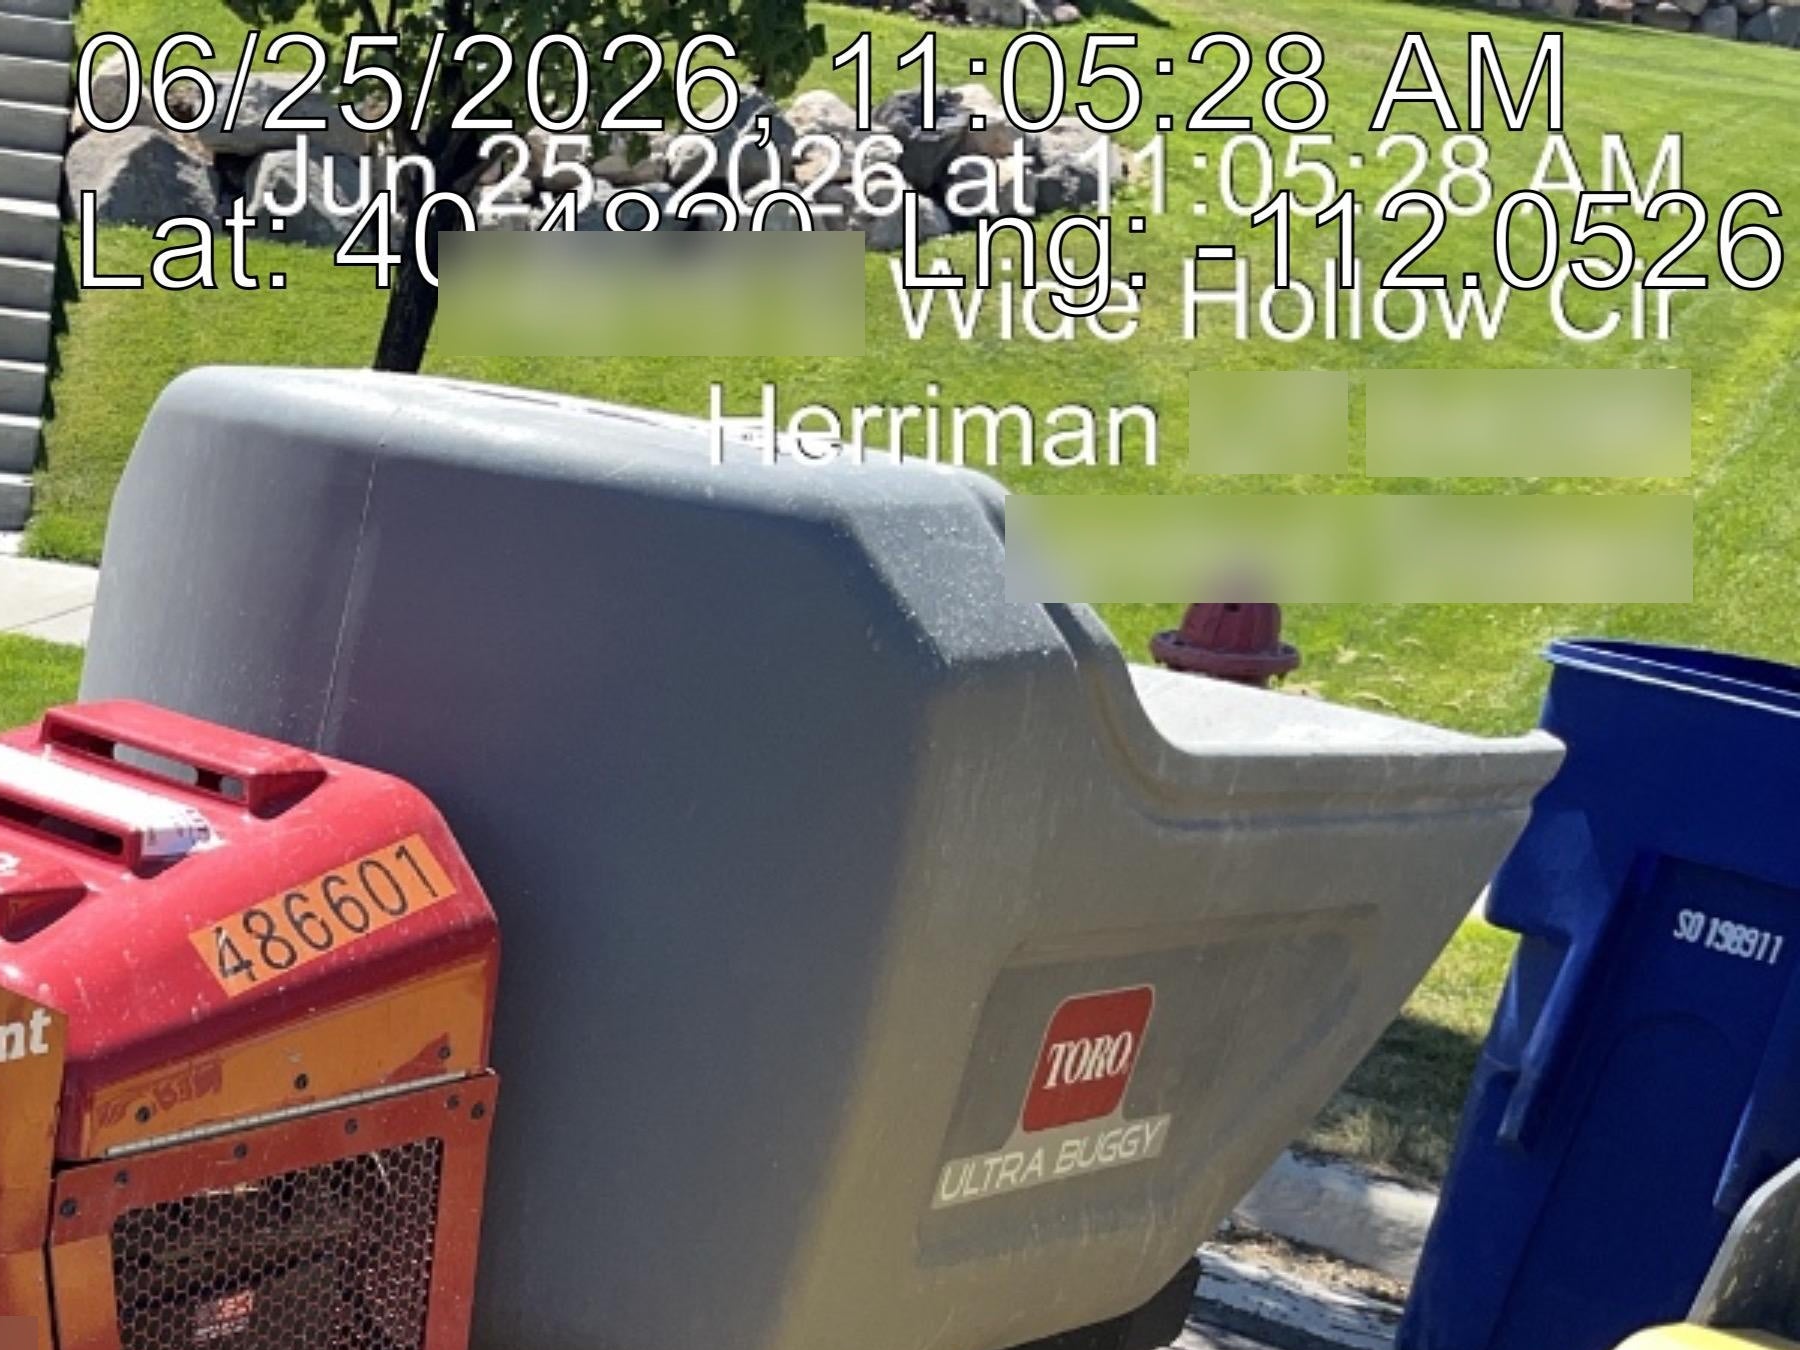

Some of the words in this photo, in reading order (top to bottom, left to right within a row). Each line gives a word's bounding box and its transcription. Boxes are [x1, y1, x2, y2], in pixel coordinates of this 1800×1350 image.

[213, 844, 439, 983] 486601
[1704, 917, 1784, 966] 198911
[1043, 1031, 1133, 1090] TORO
[940, 1148, 1044, 1201] ULTRA
[1053, 1122, 1164, 1174] BUGGY
